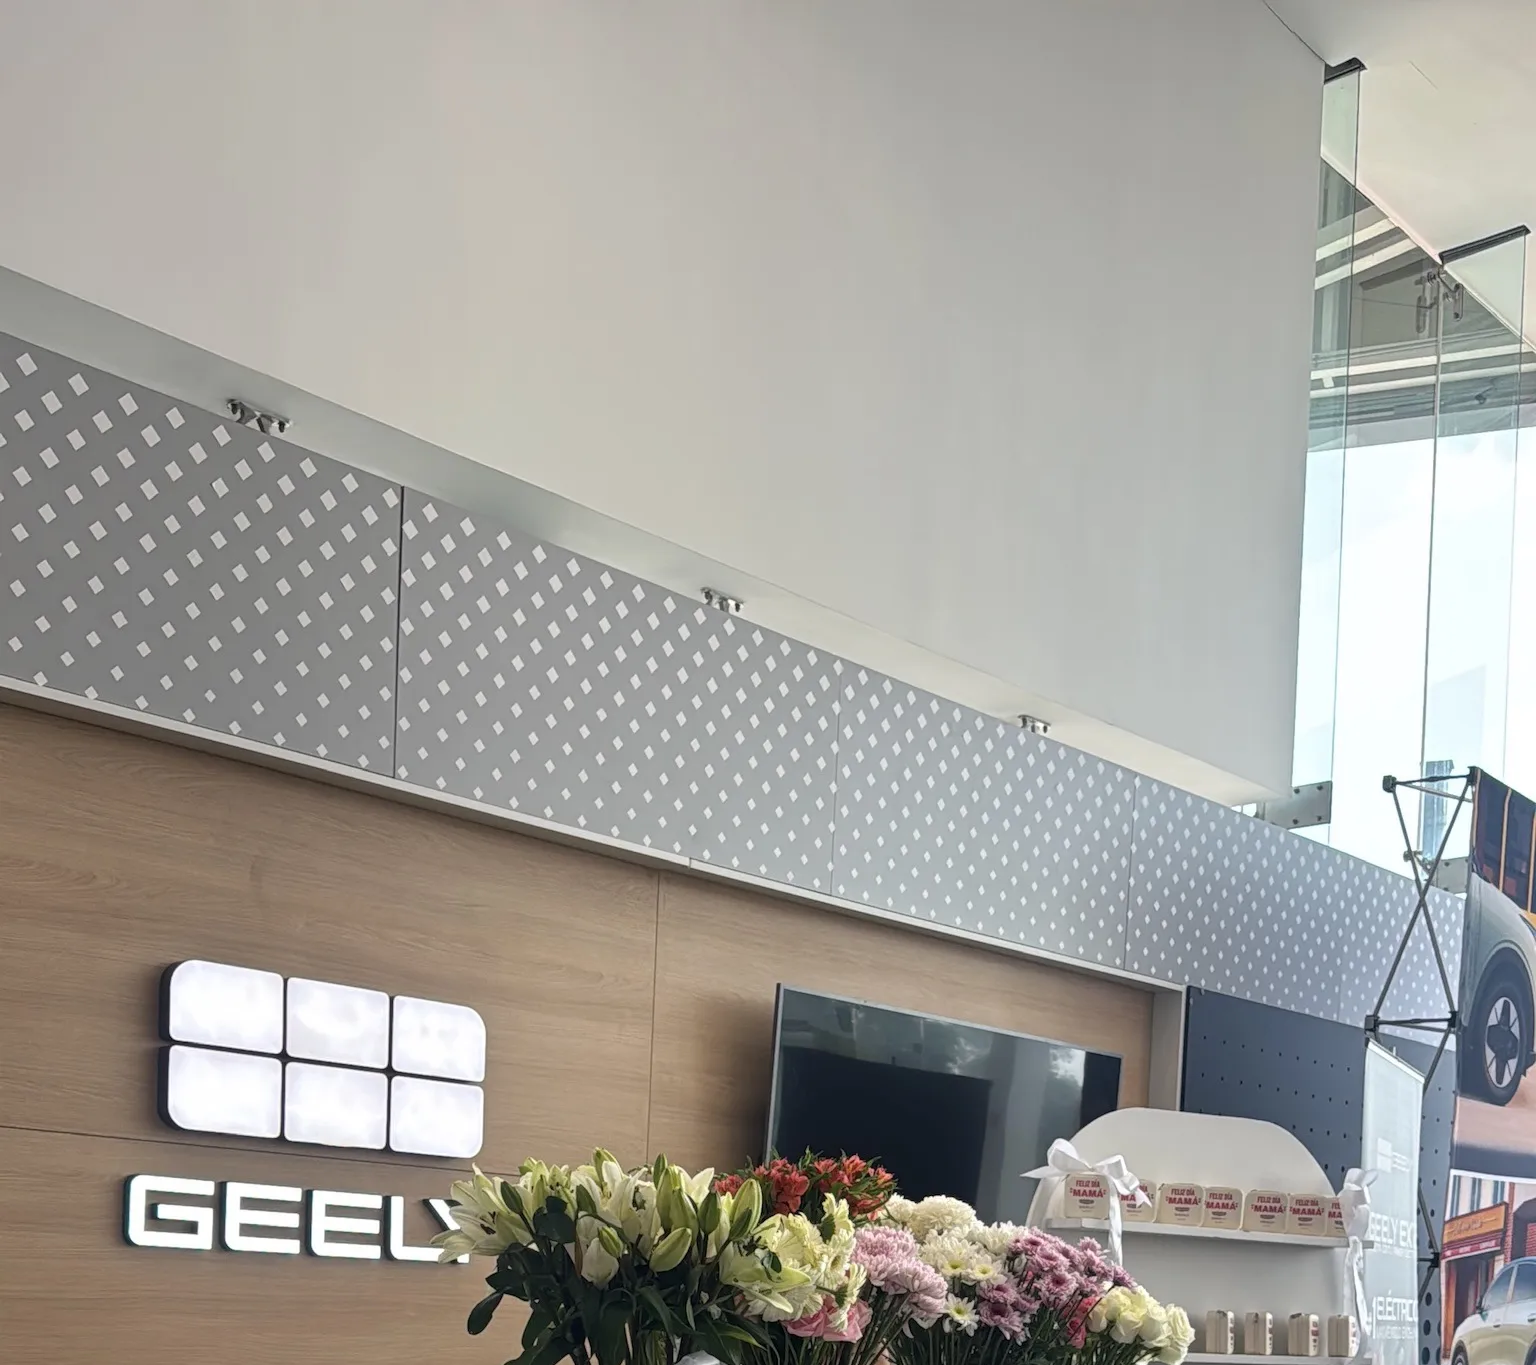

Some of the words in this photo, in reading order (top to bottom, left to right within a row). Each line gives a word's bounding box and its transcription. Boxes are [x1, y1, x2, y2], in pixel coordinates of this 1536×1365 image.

[1075, 1180, 1089, 1188] FELIZ
[1072, 1187, 1104, 1198] MAMÁ
[1171, 1188, 1185, 1196] FELIZ
[1209, 1192, 1223, 1200] FELIZ
[1168, 1195, 1199, 1206] MAMÁ
[1256, 1196, 1271, 1204] FELIZ
[1295, 1199, 1309, 1207] FELIZ
[1205, 1200, 1236, 1211] MAMÁ
[1253, 1204, 1284, 1215] MAMÁ
[1292, 1206, 1322, 1217] MAMÁ
[1328, 1211, 1343, 1219] MA
